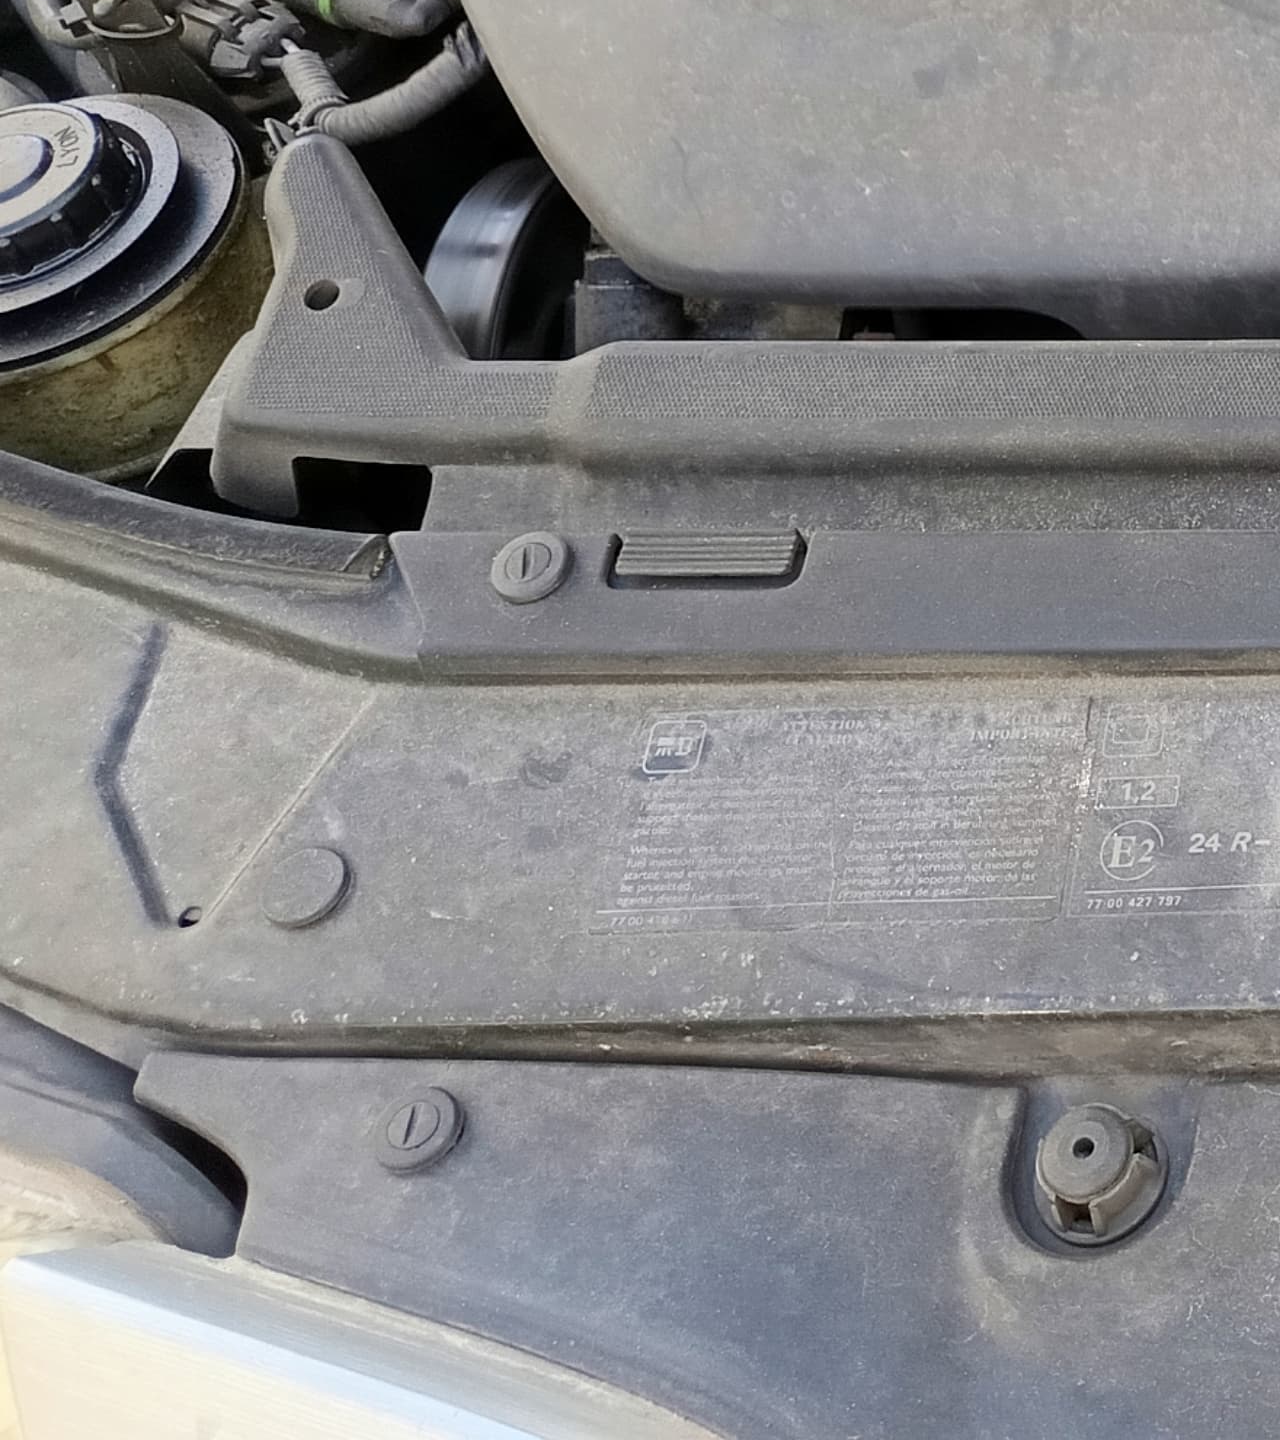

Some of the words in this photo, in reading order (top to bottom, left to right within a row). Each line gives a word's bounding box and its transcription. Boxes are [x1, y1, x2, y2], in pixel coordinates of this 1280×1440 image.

[53, 124, 81, 168] LYON
[1121, 780, 1157, 805] 1,2
[1107, 834, 1156, 869] E2
[1187, 832, 1222, 854] 24
[1087, 898, 1104, 910] 77
